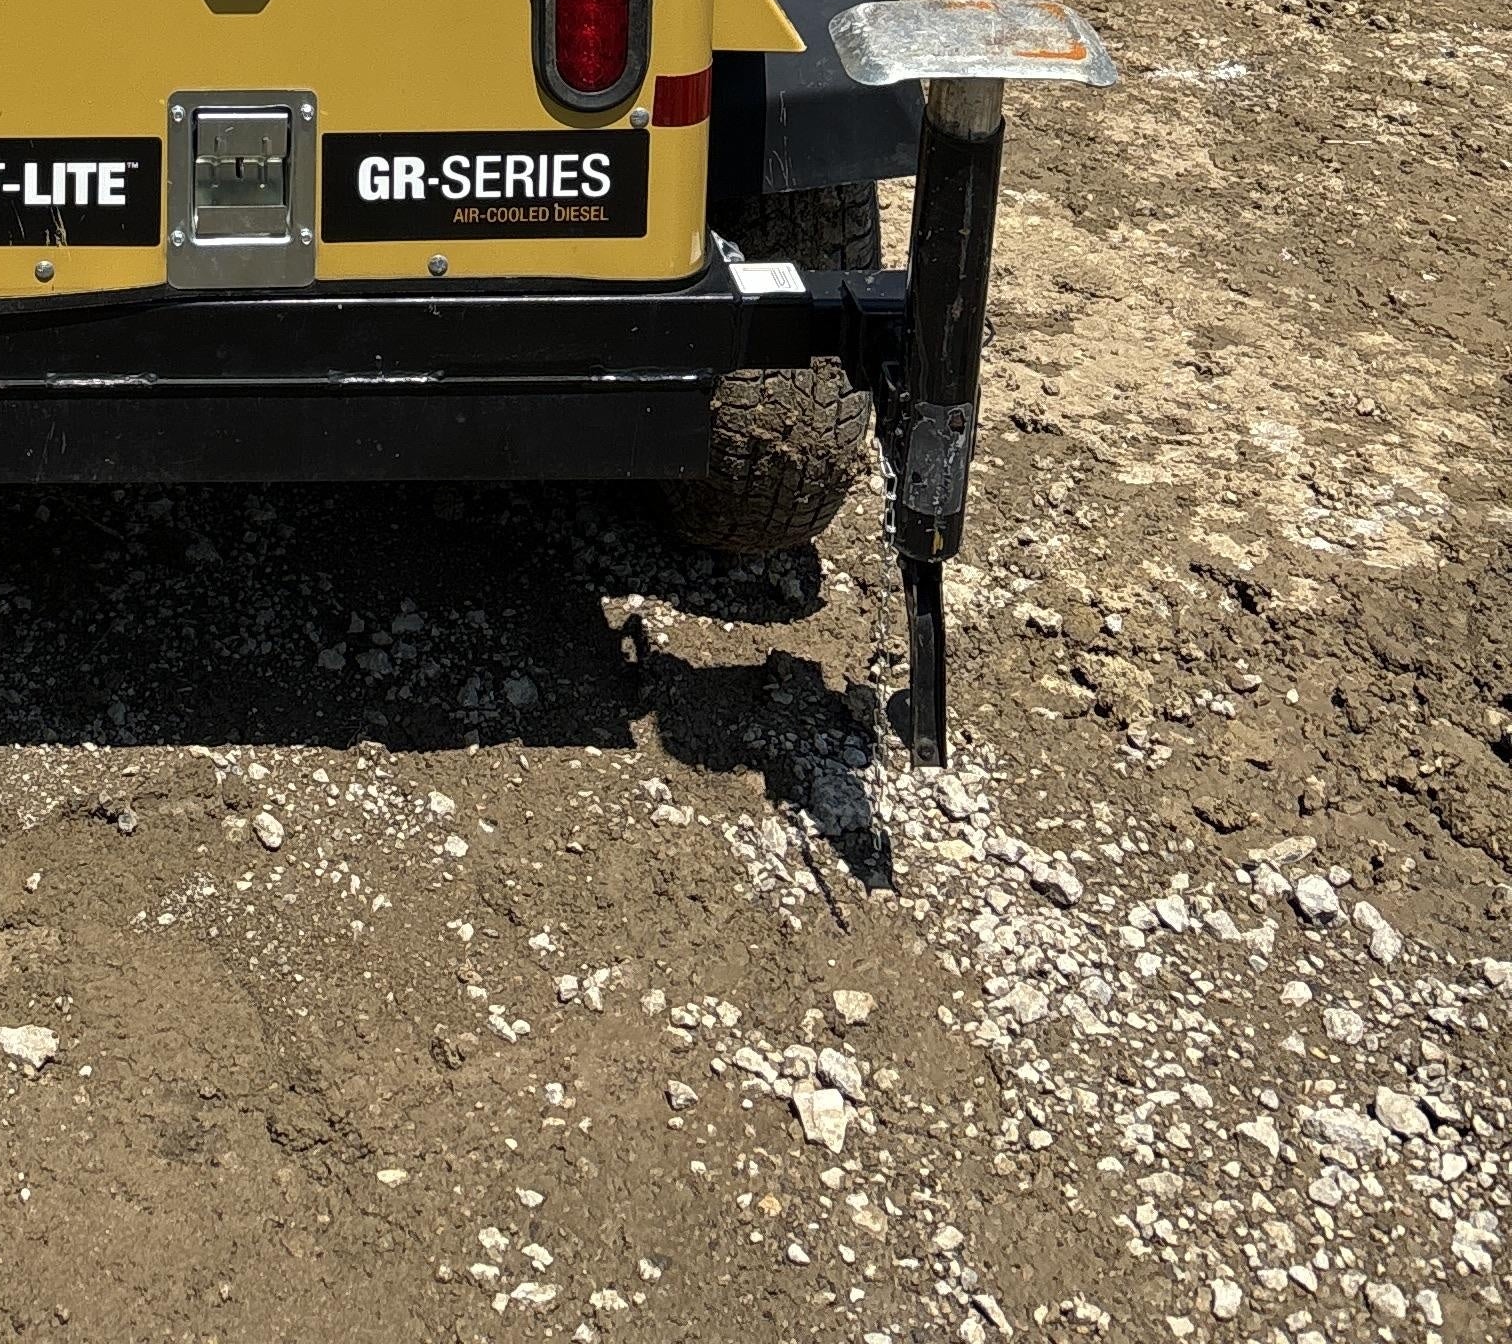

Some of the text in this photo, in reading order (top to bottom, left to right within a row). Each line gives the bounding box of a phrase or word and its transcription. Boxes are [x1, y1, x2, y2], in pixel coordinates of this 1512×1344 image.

[357, 153, 611, 201] GR-SERIES
[453, 204, 609, 224] AIR-COOLED DIESEL
